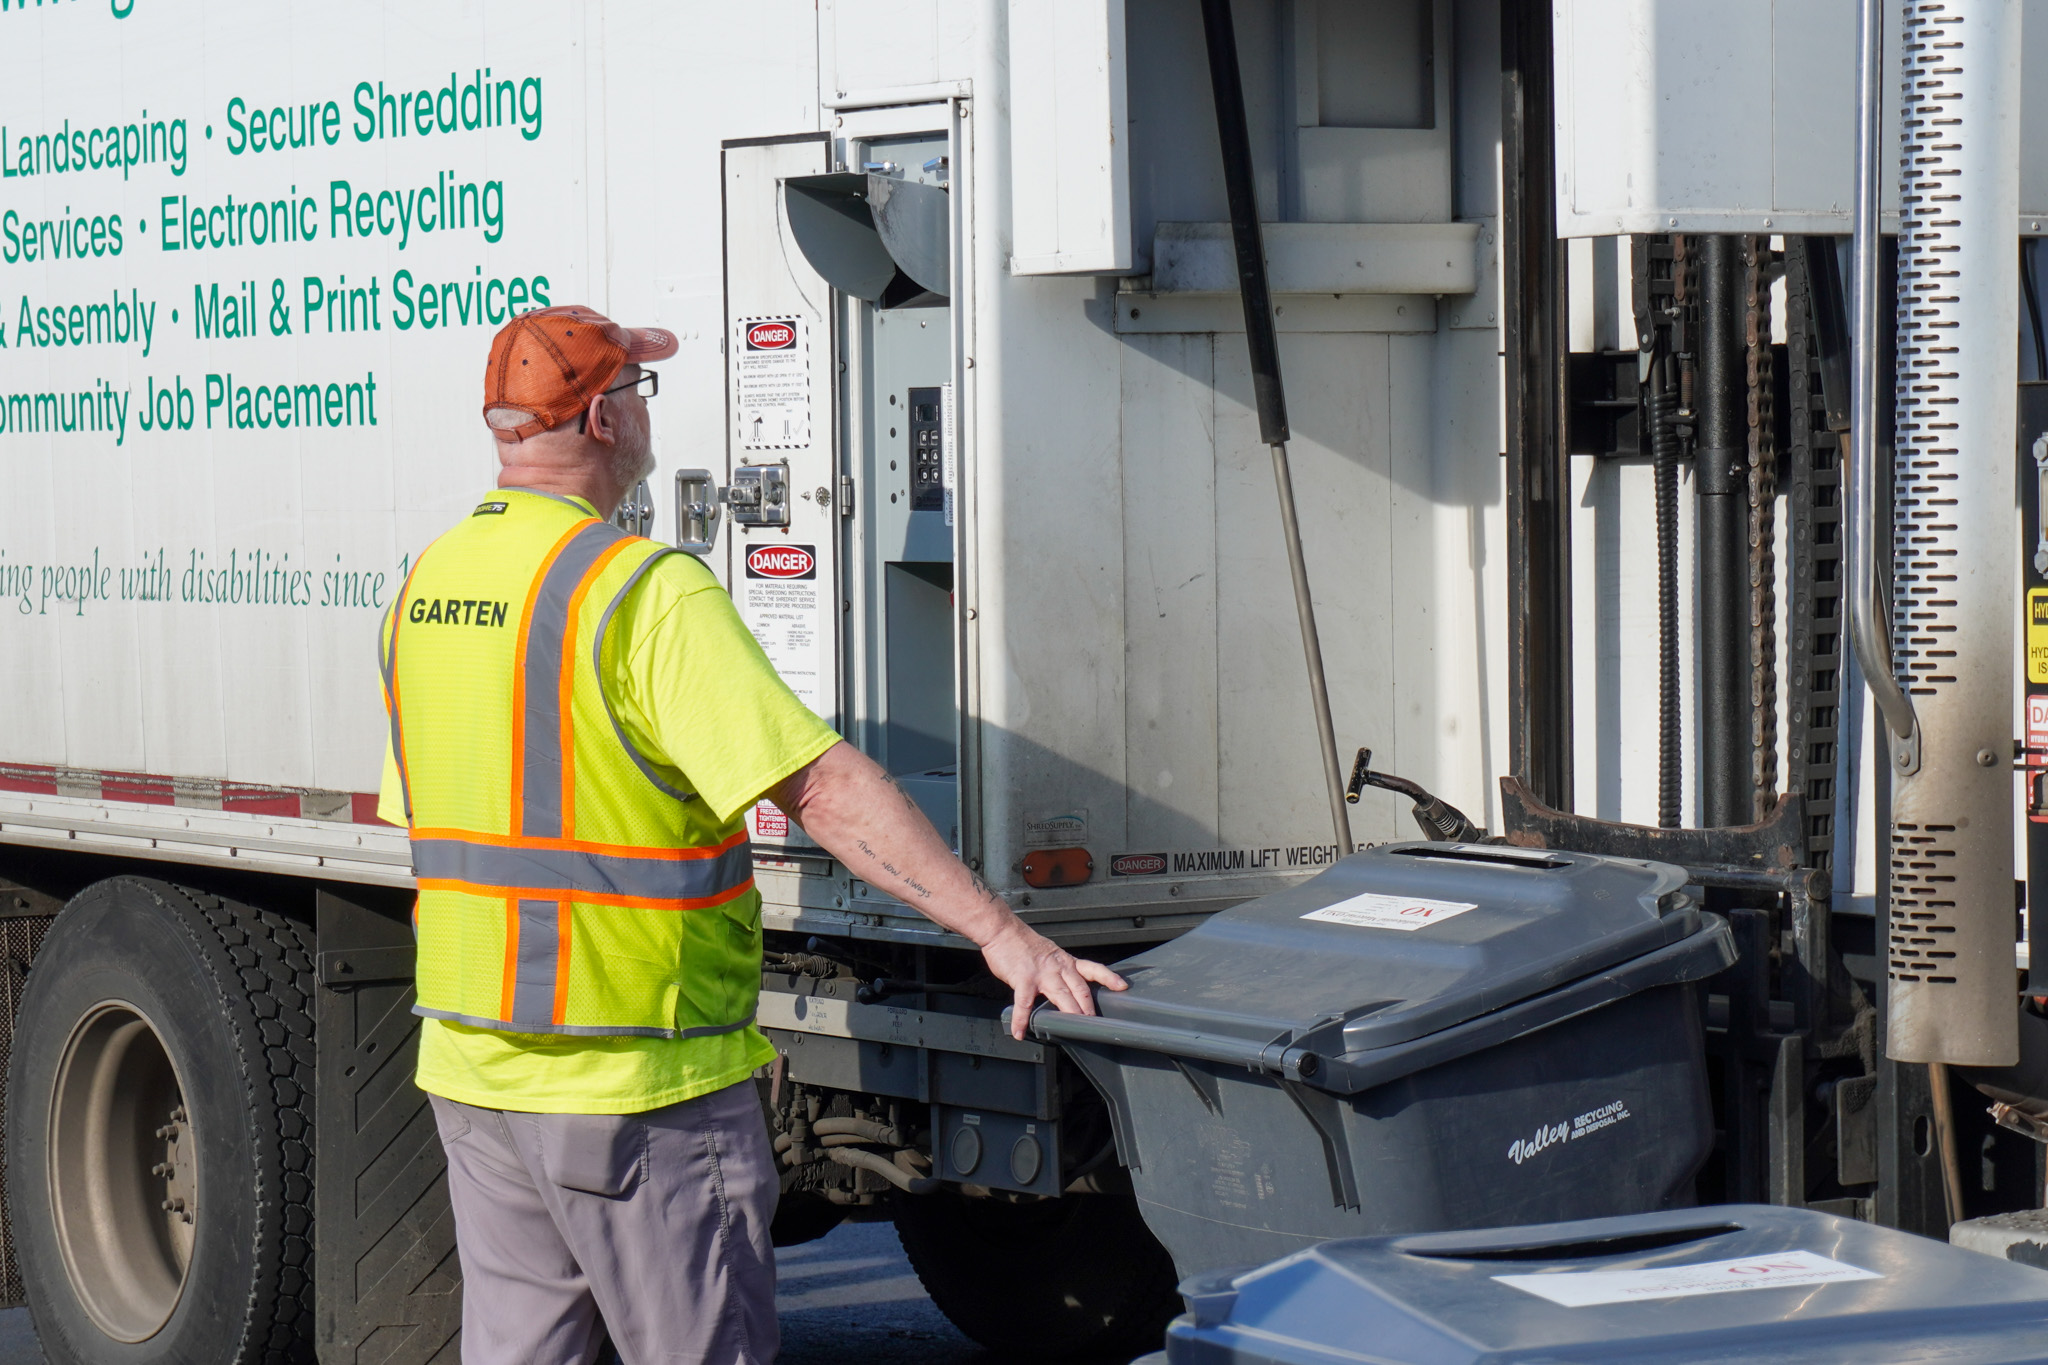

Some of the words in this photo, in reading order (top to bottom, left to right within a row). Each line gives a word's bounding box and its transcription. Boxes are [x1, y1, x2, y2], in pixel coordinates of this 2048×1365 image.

[3, 110, 187, 181] Landscaping
[227, 97, 341, 156] Secure
[353, 67, 543, 142] Shredding
[3, 205, 124, 265] Services
[161, 185, 318, 252] Electronic
[330, 170, 504, 251] Recycling
[16, 289, 157, 358] Assembly
[195, 281, 257, 340] Mail
[269, 278, 292, 337] &
[303, 275, 382, 334] Print
[392, 266, 552, 331] Services
[754, 329, 789, 342] DANGER
[139, 375, 195, 432] Job
[205, 371, 378, 430] Placement
[754, 554, 808, 570] DANGER
[39, 545, 112, 617] people
[119, 547, 173, 602] with
[182, 548, 312, 607] disabilities
[320, 554, 386, 609] since
[410, 598, 508, 628] GARTEN
[1118, 859, 1161, 870] DANGER
[1174, 850, 1244, 872] MAXIMUM
[1251, 848, 1280, 868] LIFT
[1286, 844, 1339, 866] WEIGHT
[904, 877, 932, 898] Always
[1508, 1120, 1570, 1165] Valley
[1574, 1100, 1624, 1128] RECYCLING
[1571, 1126, 1585, 1140] AND
[1586, 1117, 1617, 1134] DISPOSAL,
[1617, 1109, 1630, 1120] INC.
